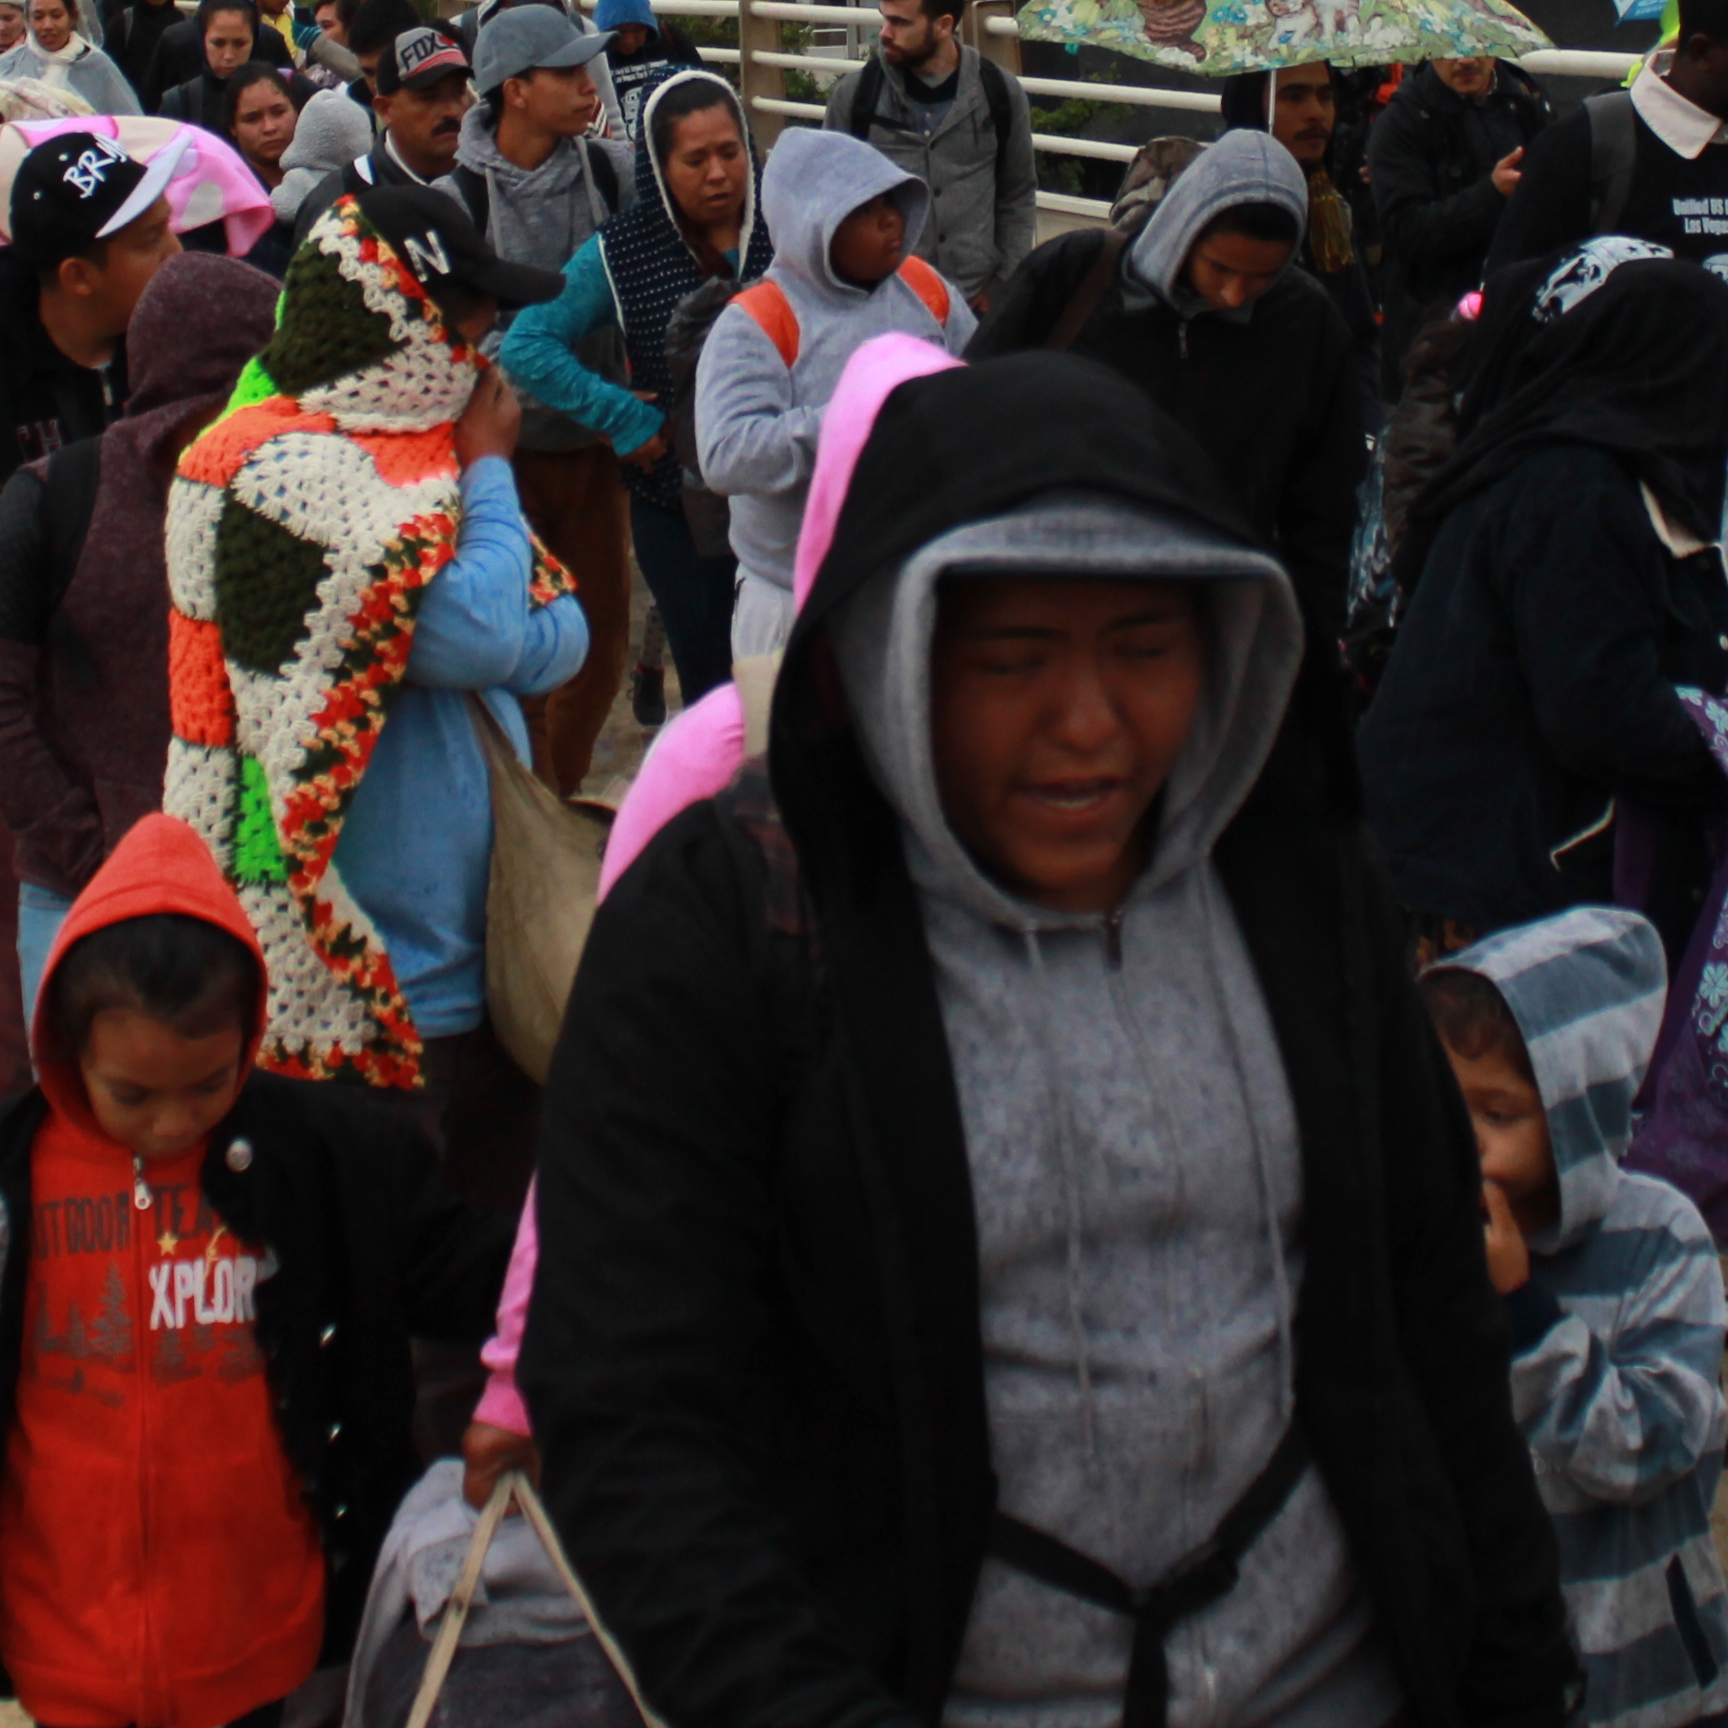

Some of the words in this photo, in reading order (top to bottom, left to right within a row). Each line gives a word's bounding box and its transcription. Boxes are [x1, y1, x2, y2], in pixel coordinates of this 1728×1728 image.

[399, 32, 458, 72] FOX
[1709, 198, 1724, 216] US
[1684, 217, 1702, 234] Las
[403, 231, 450, 282] N
